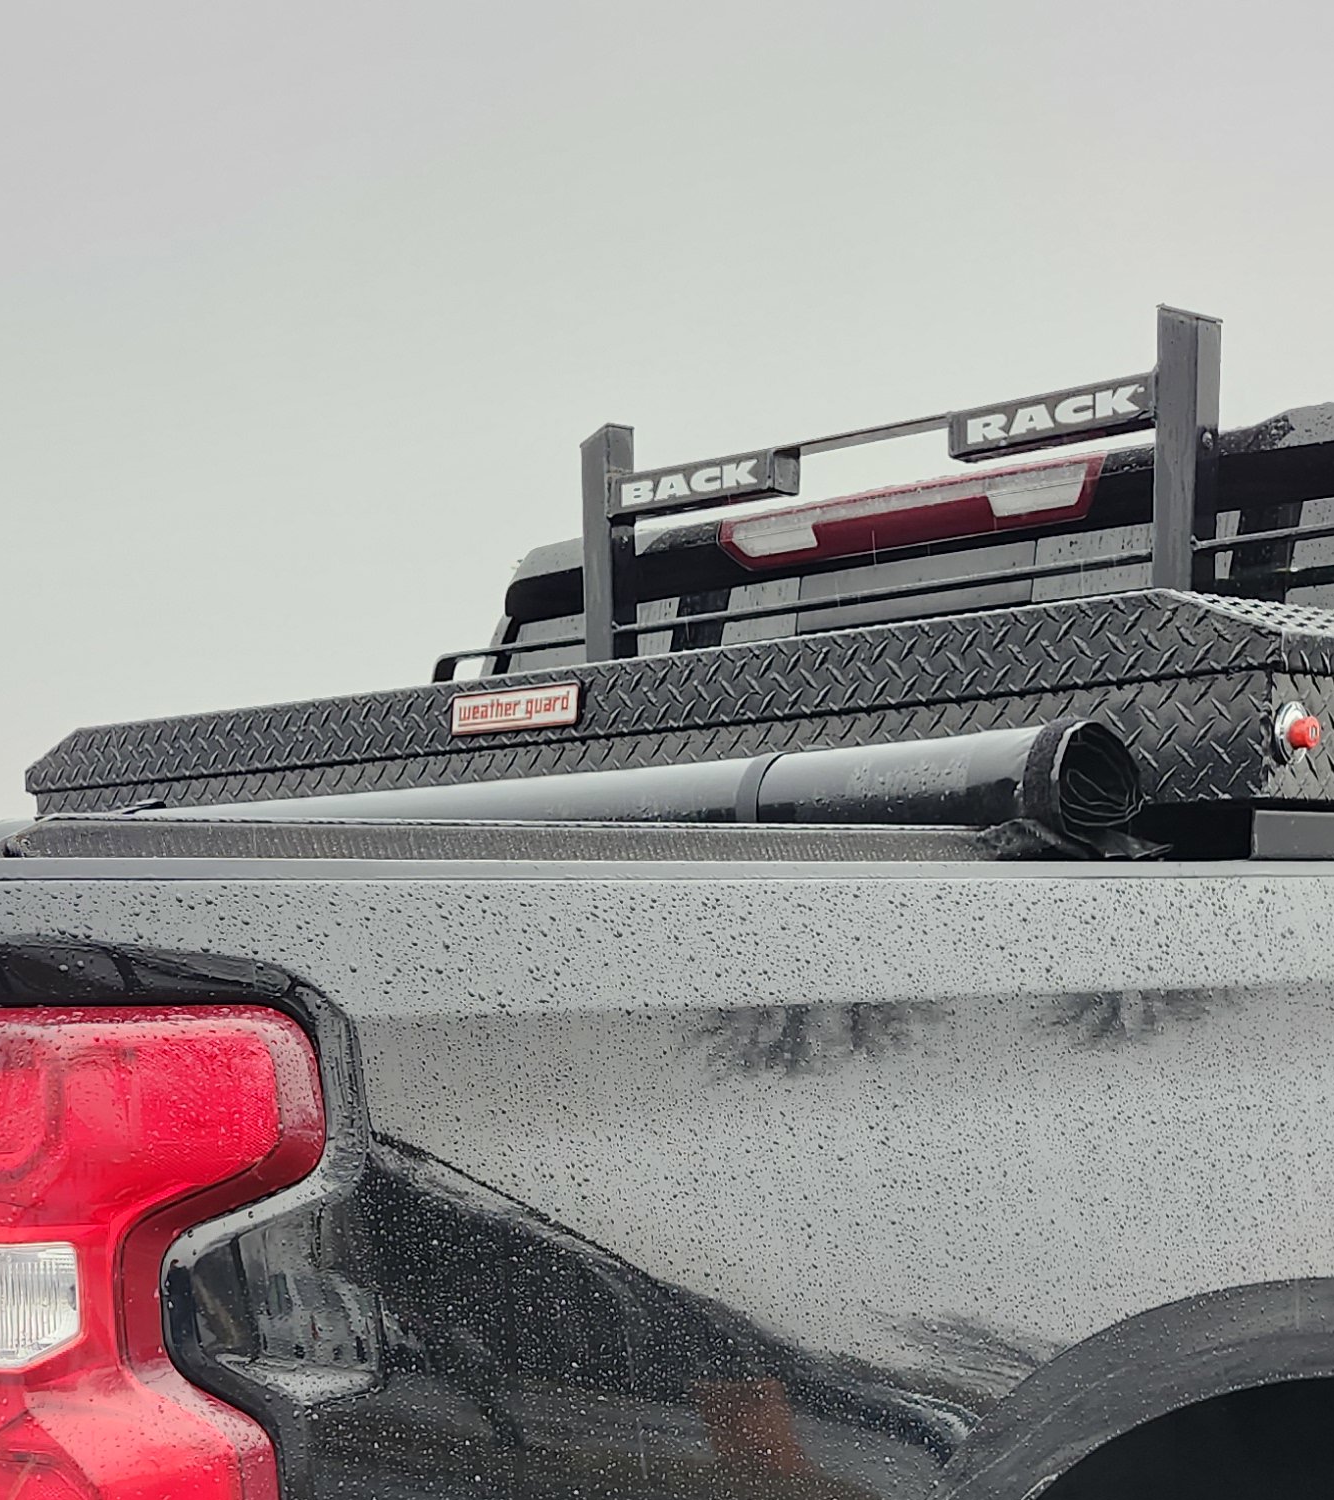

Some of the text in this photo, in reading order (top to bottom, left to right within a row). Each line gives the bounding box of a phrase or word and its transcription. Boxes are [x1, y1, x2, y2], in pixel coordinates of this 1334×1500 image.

[967, 384, 1143, 446] RACK
[621, 458, 759, 506] BACK
[458, 690, 571, 722] weather guard
